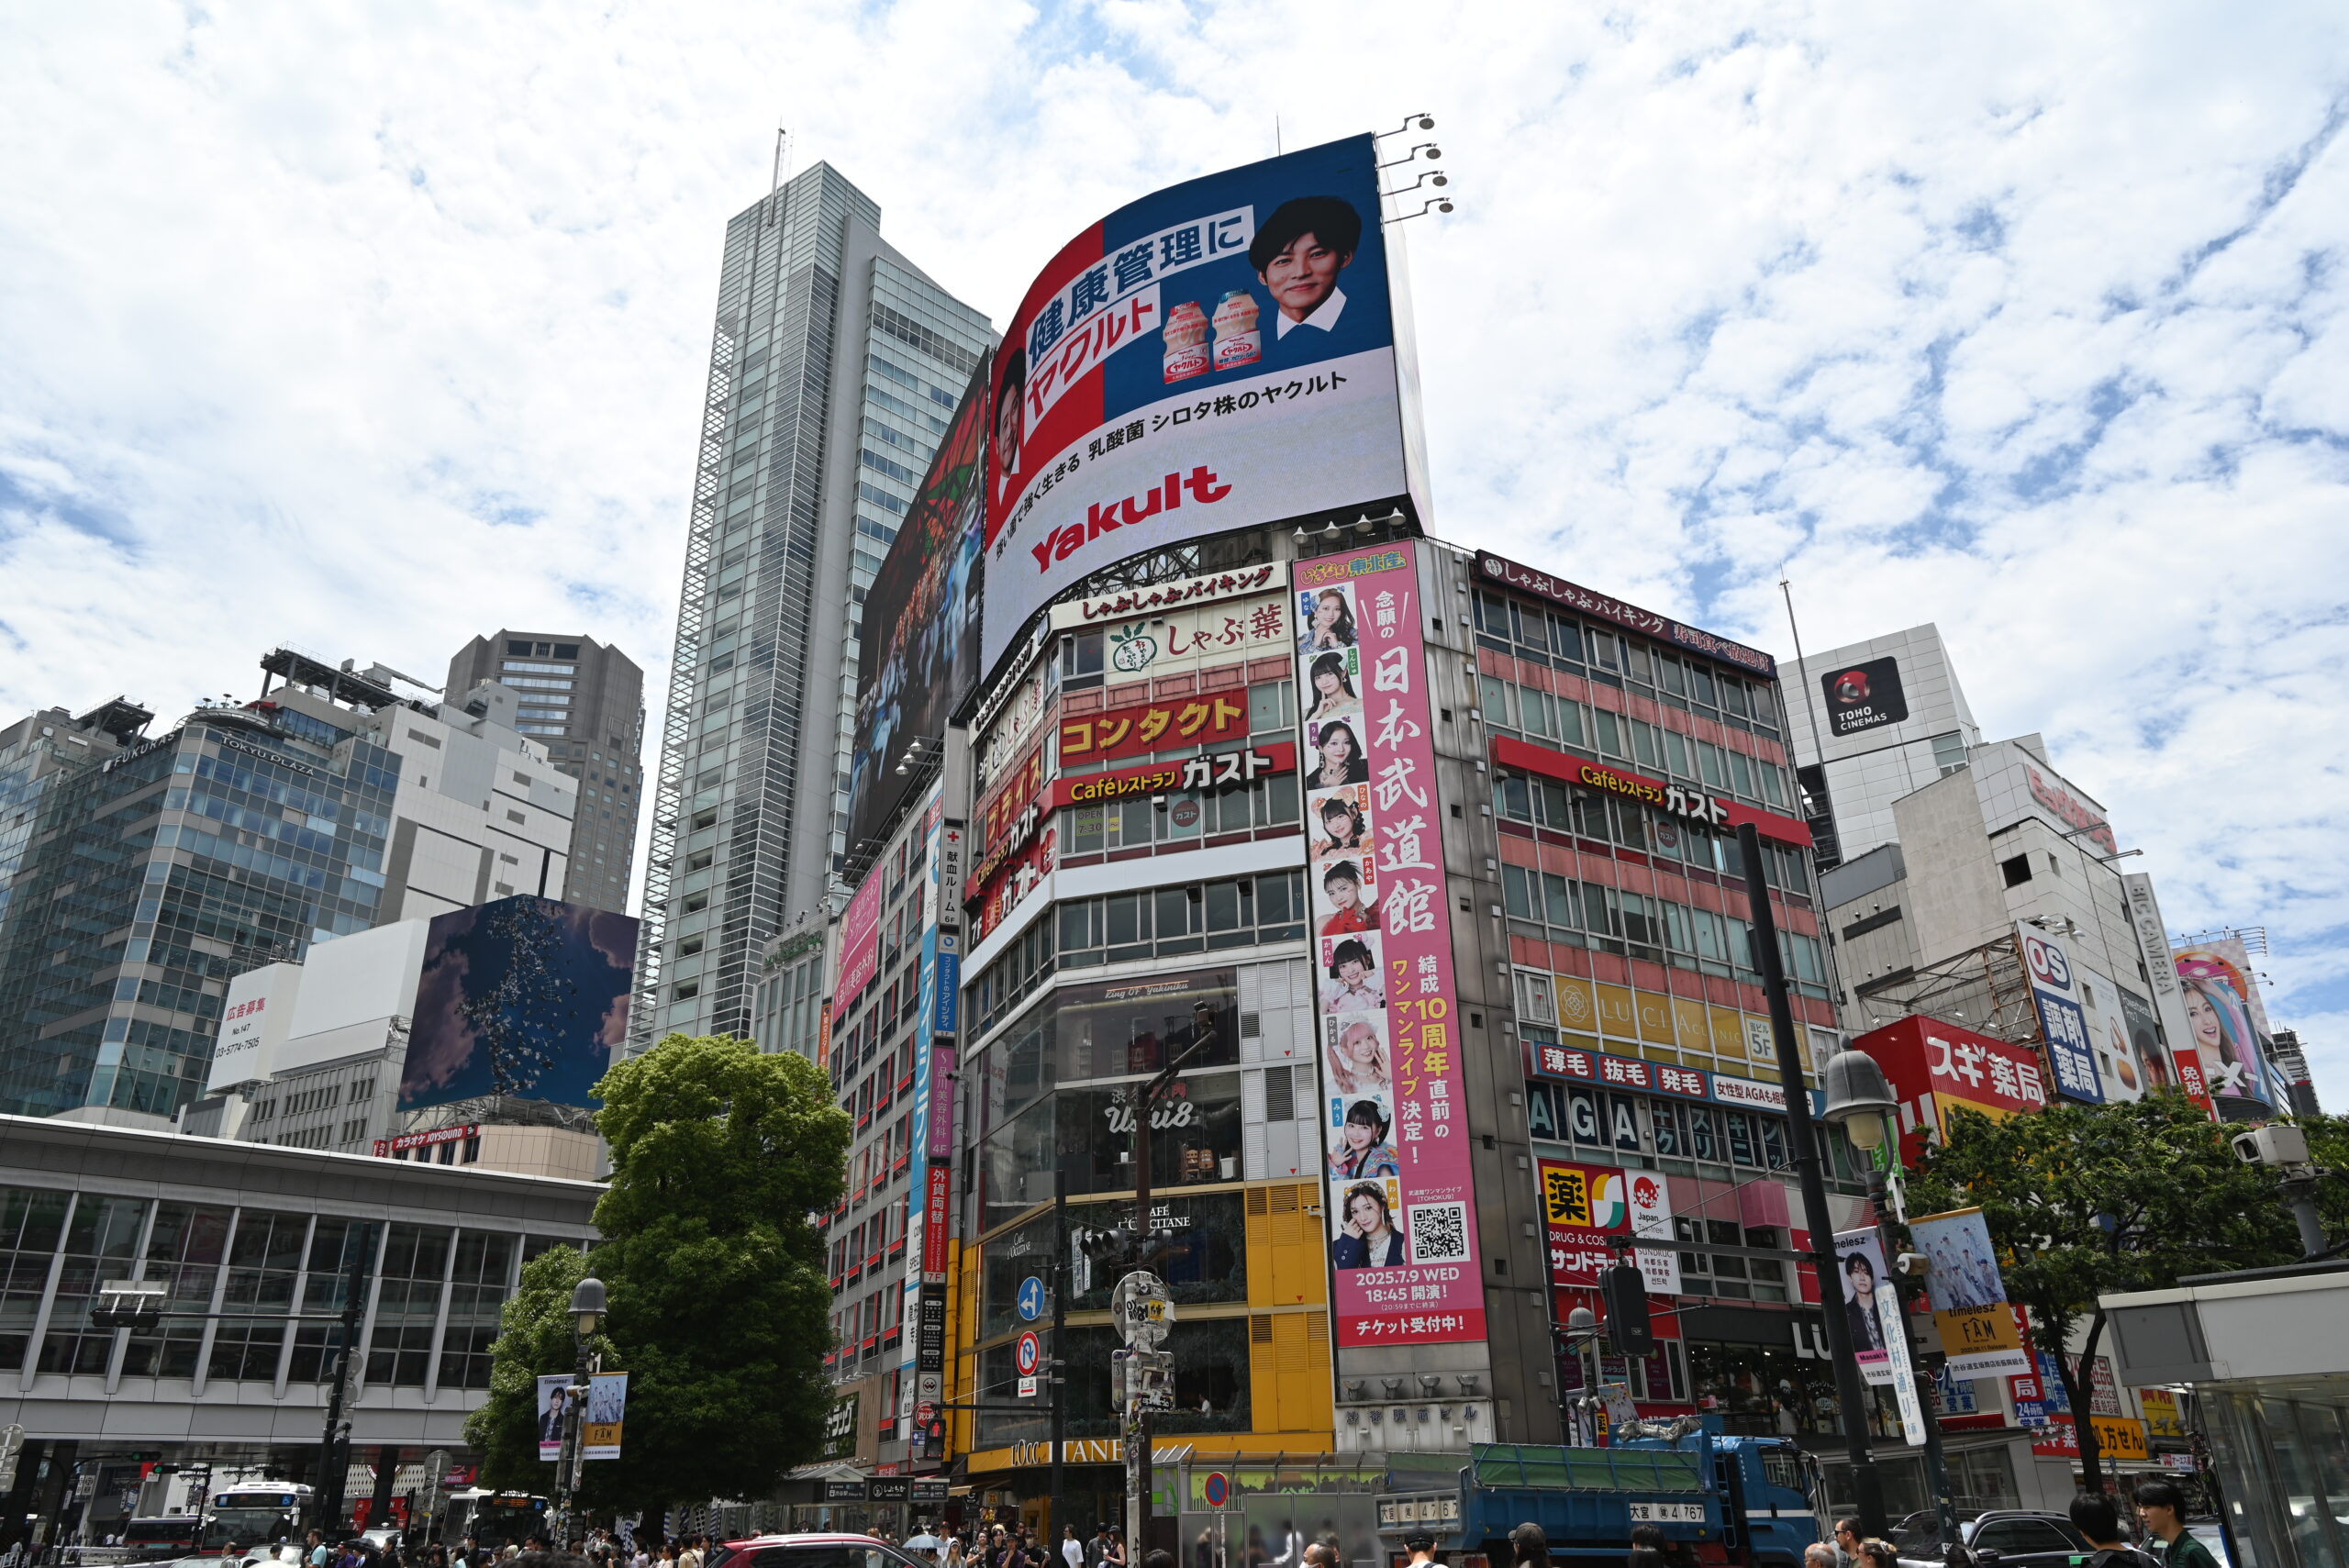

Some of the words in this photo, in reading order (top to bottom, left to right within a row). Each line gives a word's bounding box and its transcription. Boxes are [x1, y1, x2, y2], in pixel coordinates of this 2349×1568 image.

[1030, 214, 1246, 361] 健康管理に
[1027, 297, 1153, 420] ヤクルト
[1088, 418, 1145, 461] 乳酸菌
[1152, 371, 1348, 432] シロタ株のヤクルト
[1030, 465, 1232, 575] Yakult
[1082, 565, 1275, 619] しゃぶしゃぶバイキング
[1505, 562, 1665, 633] しゃぶしゃぶバイキング
[1168, 603, 1284, 656] しゃぶ葉
[1375, 591, 1397, 639] 念願の
[1673, 623, 1770, 672] 寿司食べ放題付
[1062, 697, 1244, 755] コンタクト
[1839, 706, 1873, 721] TOHO
[1840, 712, 1887, 731] CINEMAS
[113, 731, 175, 768] FUKURAS
[221, 736, 268, 760] TOKYU
[270, 753, 315, 776] PLAZA
[1183, 748, 1272, 791] ガスト
[987, 751, 1042, 842] プライス
[1374, 646, 1437, 935] 日本武道館
[1665, 783, 1729, 825] ガスト
[1009, 803, 1040, 857] ガスト
[1175, 811, 1197, 820] ガスト
[1659, 830, 1675, 842] ガスト
[945, 851, 958, 913] 献血ルーム
[2131, 884, 2151, 915] BIC
[944, 916, 955, 924] 6F
[971, 916, 983, 946] 7F
[2027, 939, 2068, 984] OS
[2139, 917, 2176, 995] CAMERA
[226, 996, 266, 1021] 広告募集
[1600, 997, 1690, 1036] LUCIA
[1749, 1021, 1769, 1034] 当ビル
[2042, 997, 2087, 1050] 調剤
[215, 1037, 261, 1058] 03-5774-7505
[1415, 955, 1451, 1139] 結成10周年直前の
[1752, 1034, 1771, 1056] 5F
[1544, 1049, 1589, 1076] 薄毛
[1605, 1059, 1648, 1086] 抜毛
[1661, 1069, 1703, 1095] 発毛
[1927, 1036, 2046, 1106] スギ薬局
[2053, 1043, 2099, 1097] 薬局
[2181, 1065, 2205, 1095] 免税
[934, 1066, 948, 1139] 品川美容外科
[1530, 1090, 1638, 1145] AGA
[395, 1134, 426, 1149] カラオケ
[427, 1128, 462, 1143] JOYSOUND
[1691, 1108, 1778, 1141] スキン
[378, 1142, 386, 1158] カラ
[933, 1144, 947, 1153] 4F
[1657, 1130, 1782, 1170] クリニッ
[930, 1169, 946, 1224] 外貨両替
[1149, 1204, 1170, 1217] AFÉ
[1547, 1172, 1587, 1222] 薬
[1118, 1217, 1191, 1230] L'OCITANE
[1549, 1231, 1575, 1244] DRUG
[1577, 1234, 1586, 1245] &
[1586, 1236, 1608, 1246] COS
[1834, 1237, 1866, 1250] melesz
[928, 1273, 941, 1282] 7F
[1356, 1270, 1419, 1286] 2025.7.9
[1422, 1267, 1460, 1281] WED
[1365, 1288, 1408, 1302] 18:45
[1949, 1304, 1997, 1318] timelesz
[1881, 1298, 1911, 1418] 文化村通り
[2017, 1403, 2030, 1418] 24
[2091, 1387, 2117, 1399] metics
[1011, 1439, 1122, 1468] L'OCCITANE
[1630, 1506, 1650, 1519] 大宮
[1671, 1506, 1703, 1520] 4767
